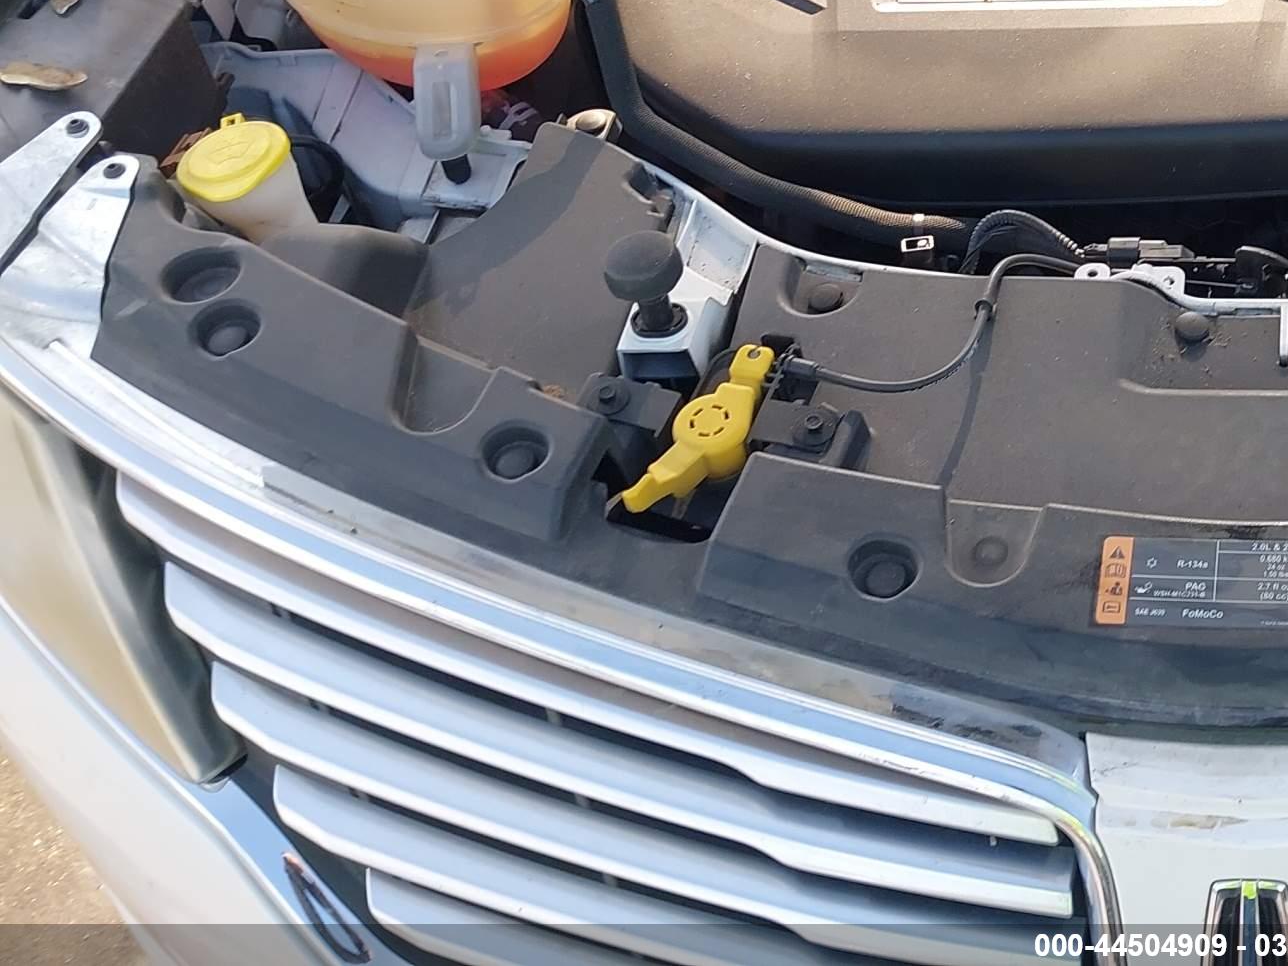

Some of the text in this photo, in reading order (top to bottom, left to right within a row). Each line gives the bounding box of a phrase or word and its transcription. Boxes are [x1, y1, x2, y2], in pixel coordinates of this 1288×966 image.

[1251, 542, 1271, 551] 2.0L
[1273, 543, 1281, 551] &
[1177, 559, 1209, 569] R-134a
[1185, 581, 1207, 591] PAG
[1257, 582, 1270, 591] 2.7
[1272, 582, 1280, 591] fl
[1182, 608, 1224, 619] FoMoCo
